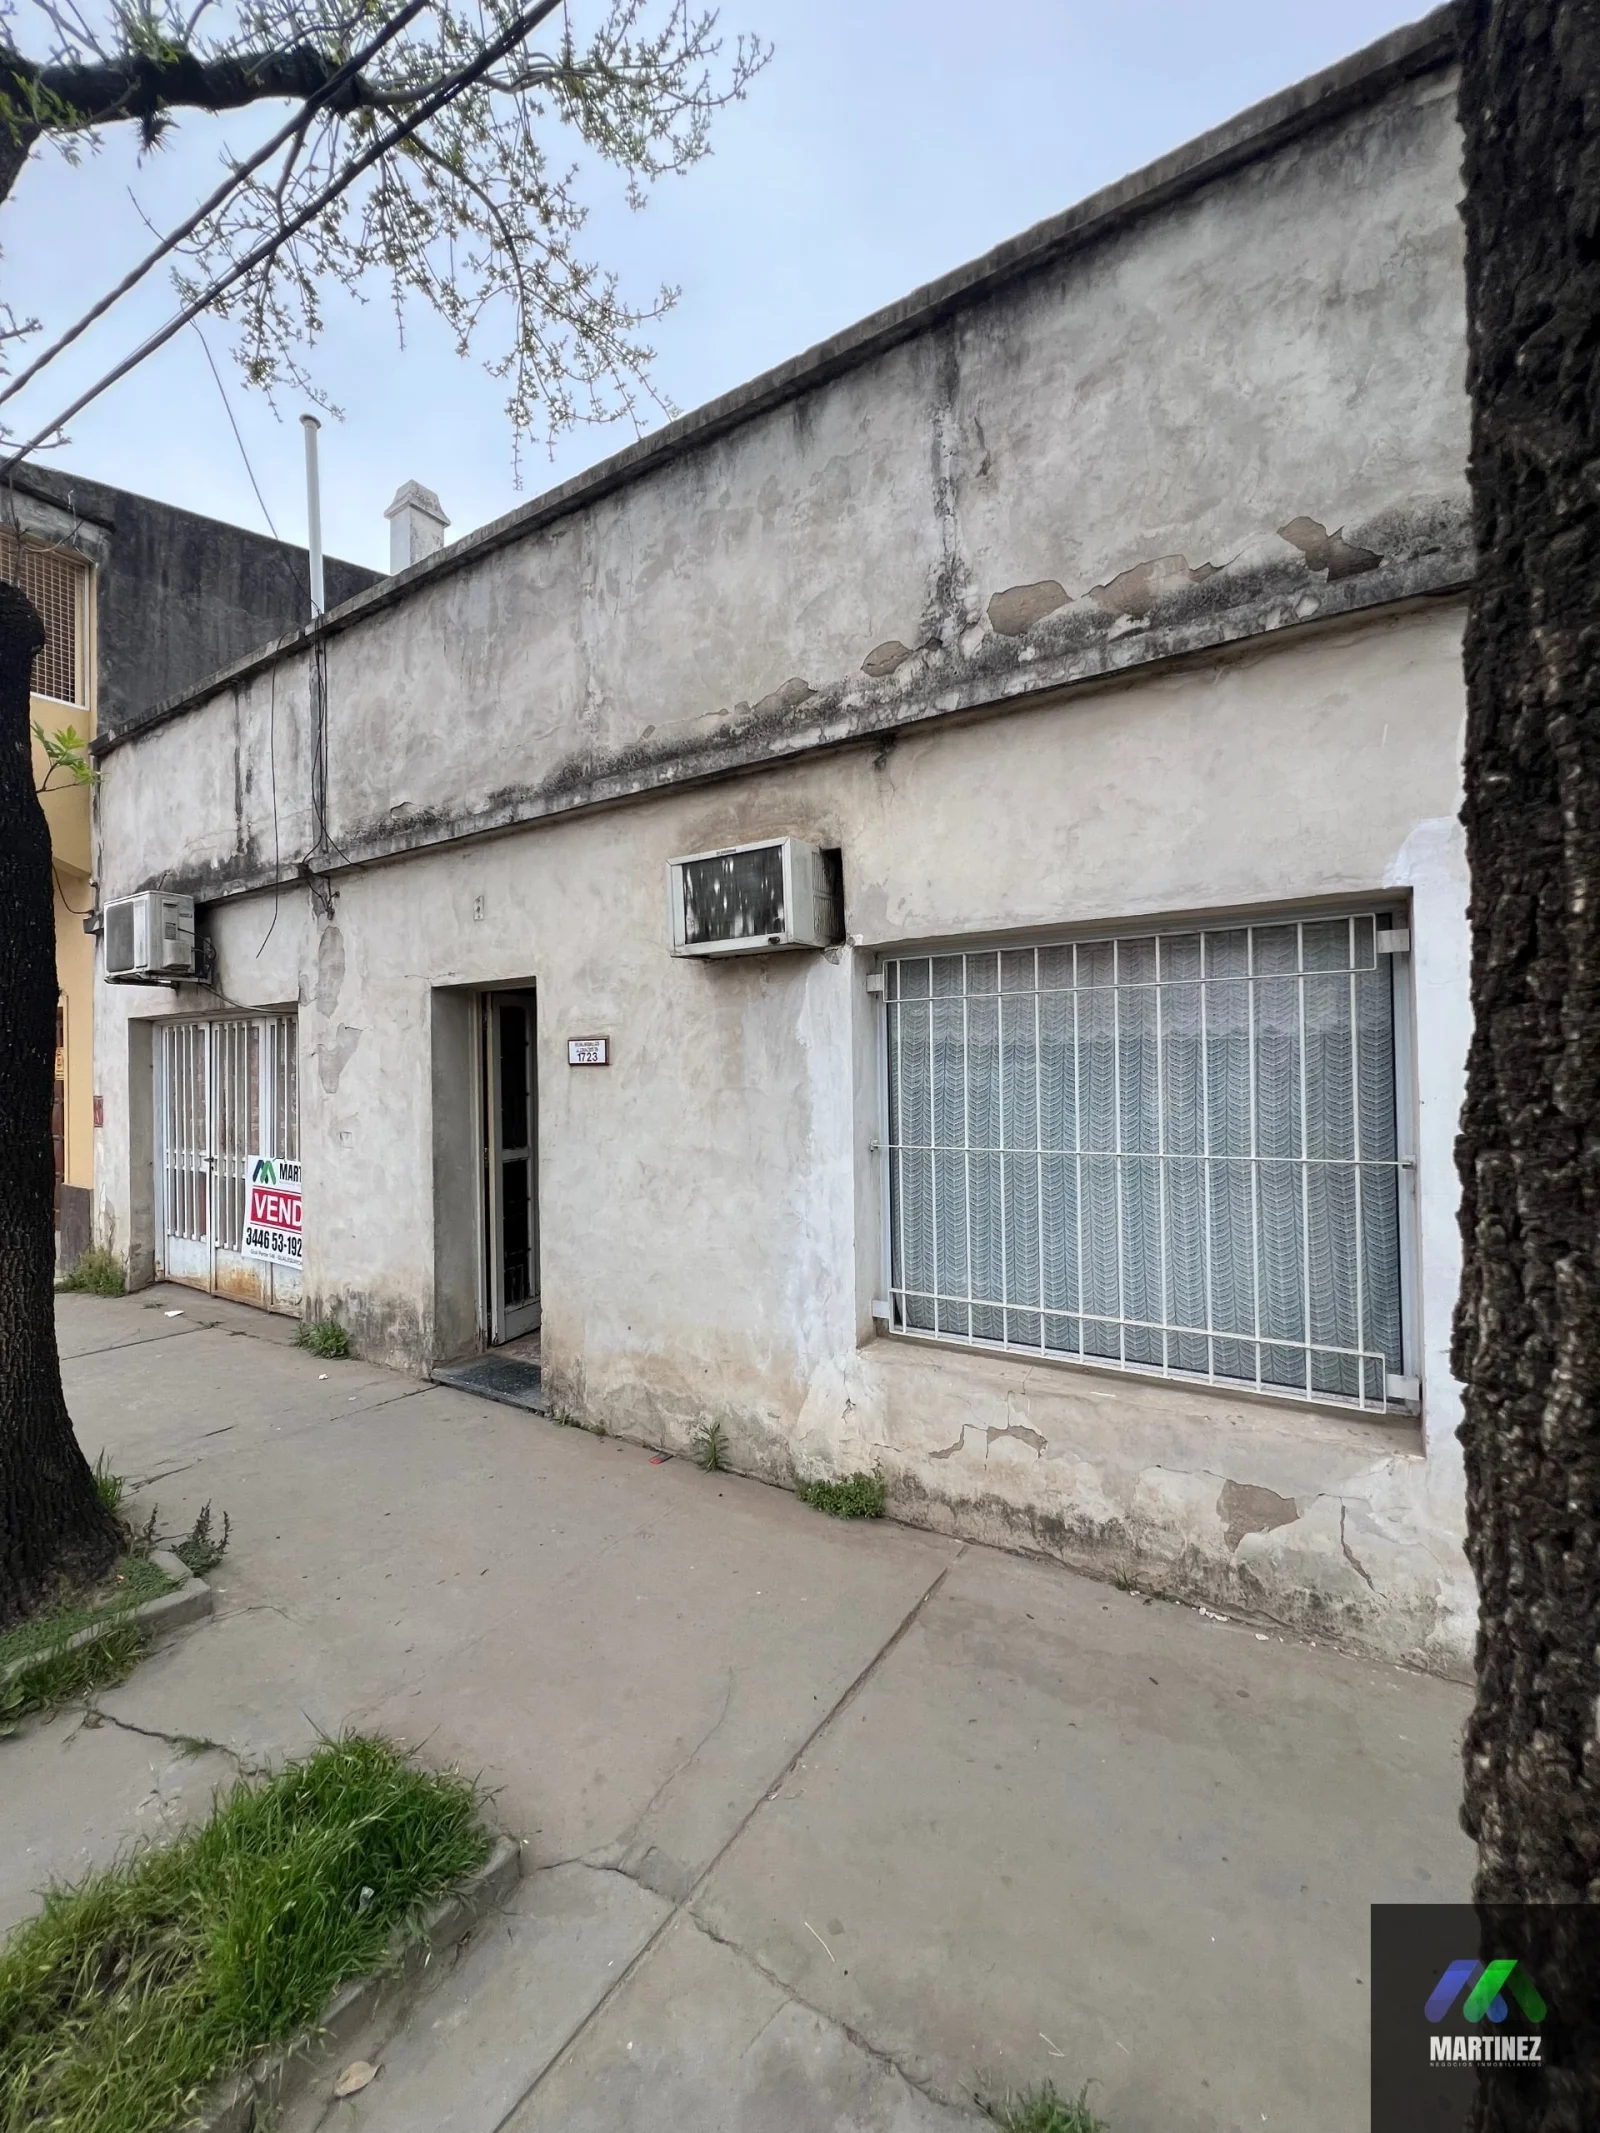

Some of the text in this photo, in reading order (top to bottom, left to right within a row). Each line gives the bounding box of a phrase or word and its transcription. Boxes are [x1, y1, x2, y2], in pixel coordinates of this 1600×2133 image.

[577, 1052, 598, 1062] 1723
[253, 1192, 303, 1227] VEND
[246, 1227, 302, 1257] 3446 53-192
